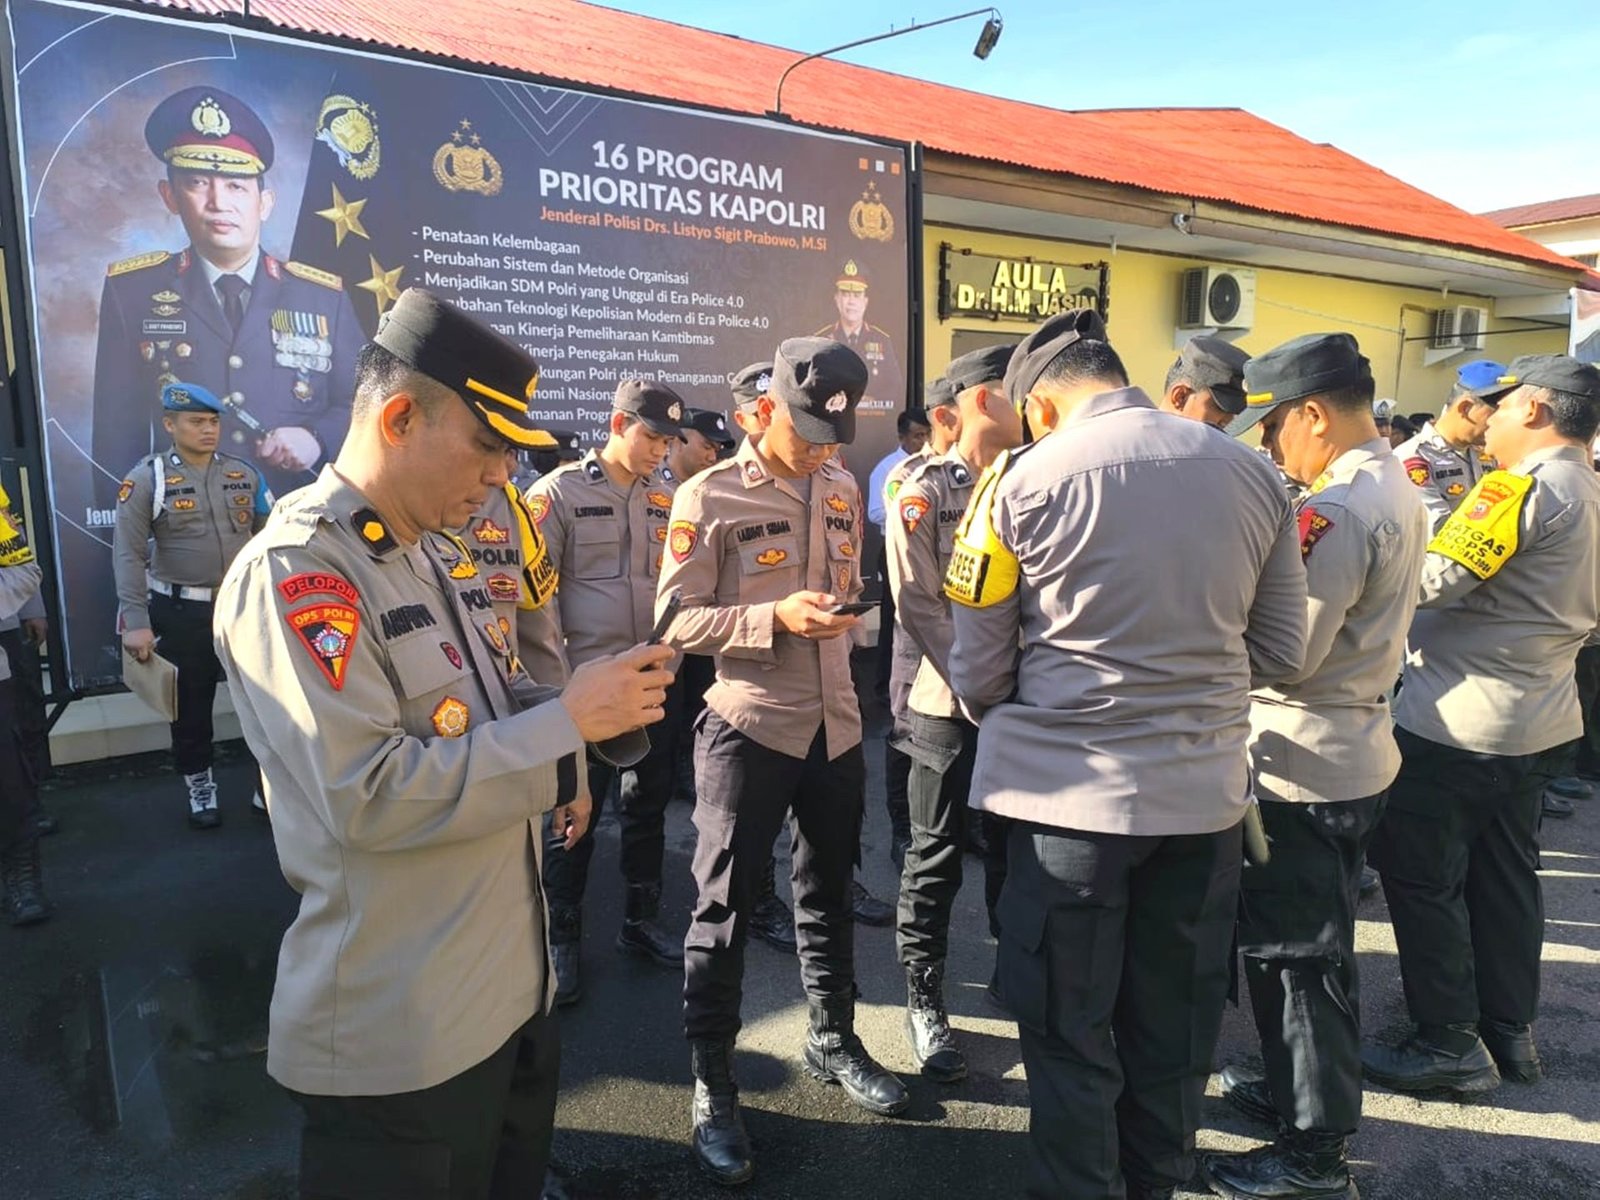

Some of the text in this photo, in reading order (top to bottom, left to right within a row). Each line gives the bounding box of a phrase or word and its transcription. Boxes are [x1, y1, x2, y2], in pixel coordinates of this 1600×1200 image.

[592, 140, 783, 192] 16 PROGRAM
[539, 168, 825, 230] PRIORITAS KAPOLRI
[422, 226, 580, 255] Penataan Kelembagaan
[540, 206, 827, 251] Jenderal Polisi Drs. Listyo Sigit Prabowo, M.Si
[423, 249, 689, 285] Perubahan Sistem dan Metode Organisasi
[994, 260, 1067, 293] AULA
[425, 272, 744, 309] Menjadikan SDM Polri yang Unggul di Era Police 4.0
[504, 299, 567, 319] Teknologi
[571, 304, 634, 321] Kepolisian
[637, 308, 682, 324] Modern
[684, 312, 695, 325] di
[698, 313, 715, 326] Era
[718, 314, 750, 328] Police
[752, 317, 769, 329] 4.0
[518, 322, 564, 340] Kinerja
[568, 325, 649, 342] Pemeliharaan
[652, 330, 715, 345] Kamtibmas
[568, 345, 635, 362] Penegakan
[637, 349, 679, 363] Hukum
[538, 365, 586, 383] kungan
[589, 367, 616, 380] Polri
[620, 368, 654, 381] dalam
[657, 370, 725, 386] Penanganan
[533, 387, 616, 401] nomi Nasiona
[576, 407, 611, 423] Progr
[1444, 520, 1506, 557] SATGAS
[286, 577, 356, 599] PELOPOR
[294, 608, 355, 625] OPS POLRI
